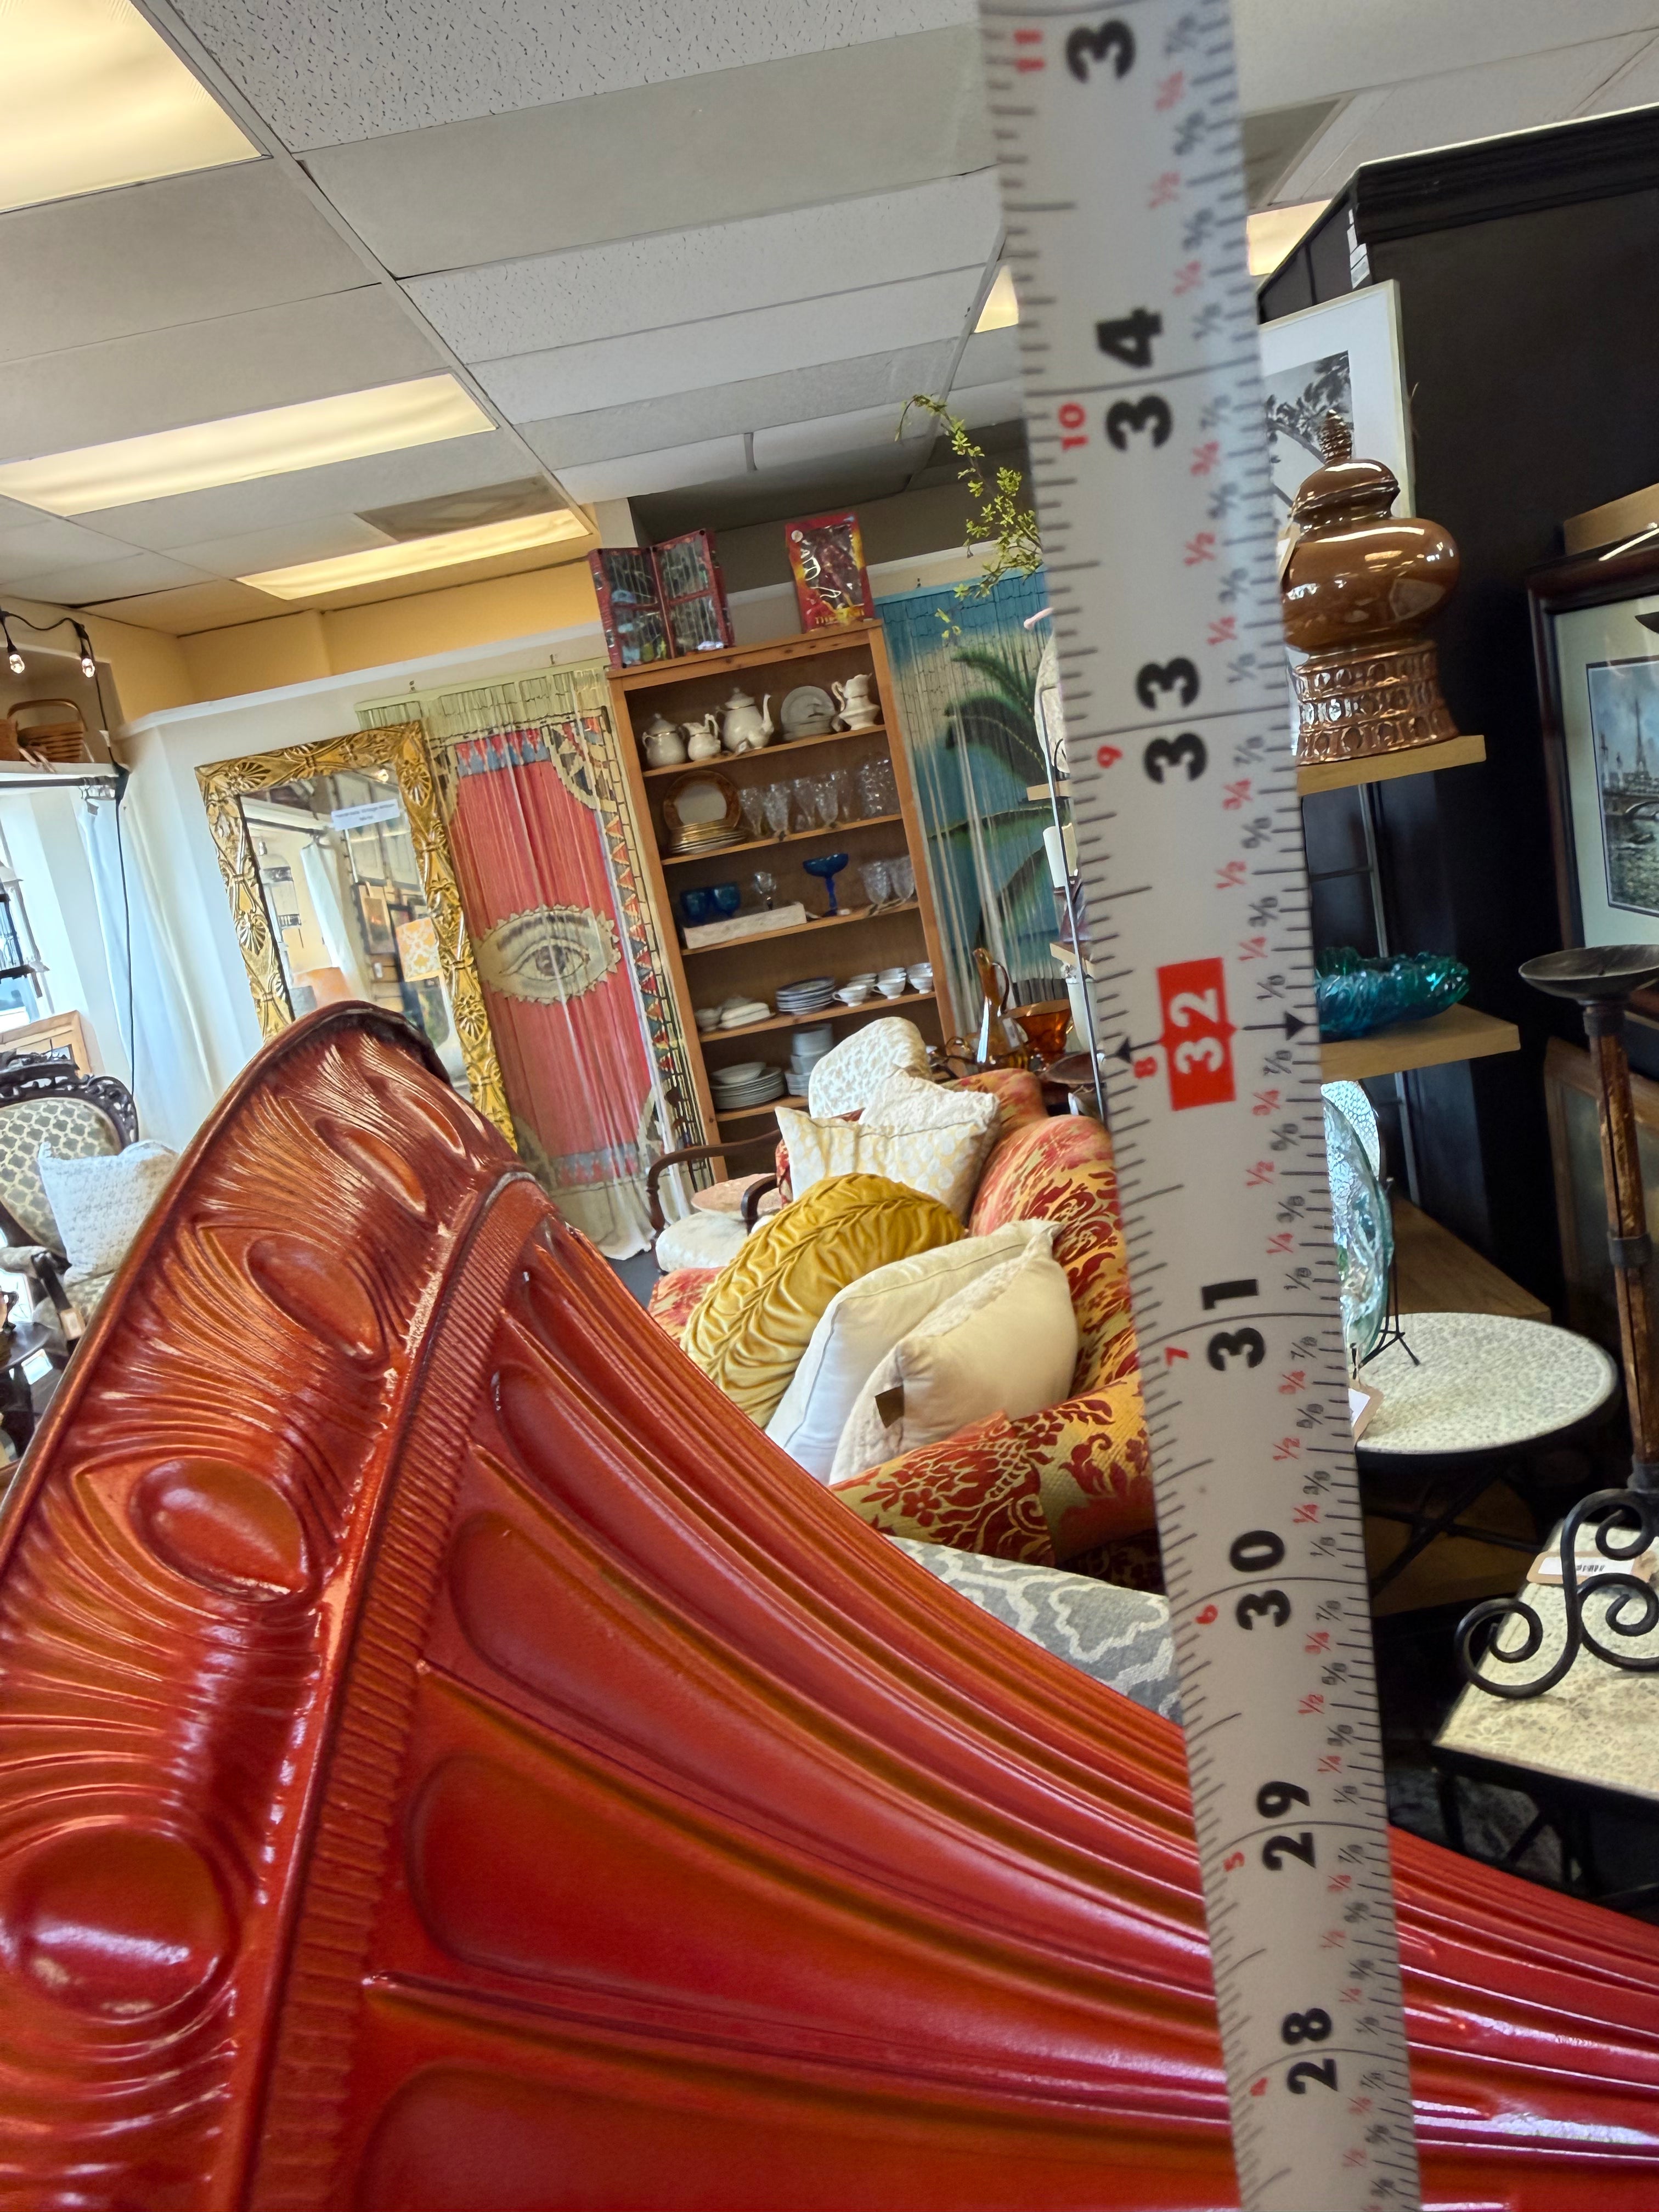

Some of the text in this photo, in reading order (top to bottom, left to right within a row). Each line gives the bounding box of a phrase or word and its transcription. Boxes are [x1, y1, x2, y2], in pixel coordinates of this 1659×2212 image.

[1094, 307, 1172, 452] 34
[1058, 403, 1088, 452] 10
[1135, 657, 1207, 783] 33
[1097, 746, 1123, 768] 9
[1170, 989, 1223, 1074] 32
[1134, 1057, 1158, 1078] 8
[1245, 1161, 1274, 1187] 1/2
[1266, 1233, 1293, 1254] 1/4
[1201, 1278, 1265, 1371] 31
[1165, 1347, 1189, 1365] 7
[1272, 1438, 1300, 1461] 1/2
[1293, 1504, 1319, 1523] 1/4
[1229, 1530, 1290, 1630] 30
[1194, 1605, 1217, 1624] 6
[1297, 1694, 1324, 1714] 1/2
[1318, 1756, 1341, 1774] 1/4
[1256, 1781, 1316, 1871] 29
[1223, 1852, 1244, 1872] 5
[1281, 2008, 1338, 2094] 28
